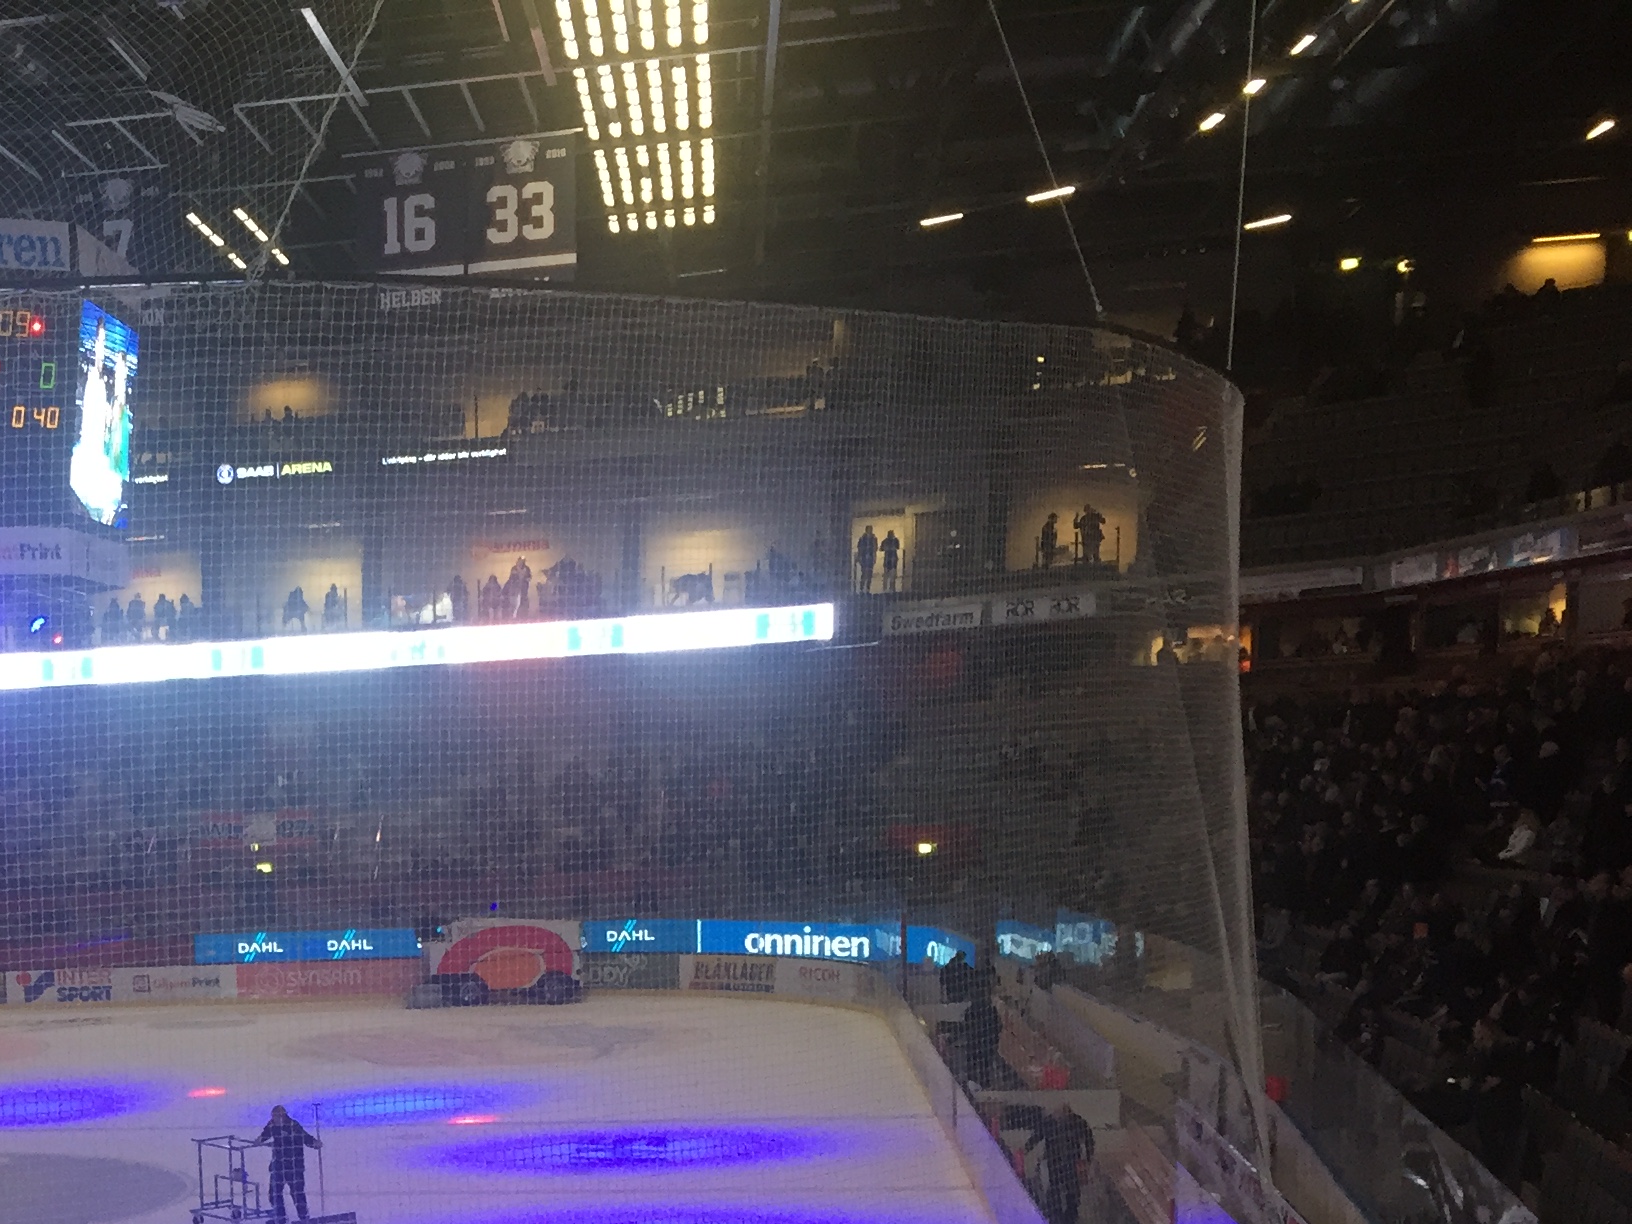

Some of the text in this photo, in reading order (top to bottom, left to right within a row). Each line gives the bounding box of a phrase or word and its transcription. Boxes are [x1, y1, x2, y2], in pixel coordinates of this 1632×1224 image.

[486, 180, 555, 244] 33
[383, 193, 436, 255] 16
[39, 362, 56, 389] 0
[236, 461, 333, 479] SAAB ARENA
[237, 939, 373, 954] DAHL DAHL
[606, 928, 655, 943] DAHL
[744, 925, 870, 958] onninen
[57, 985, 113, 1002] SPORT
